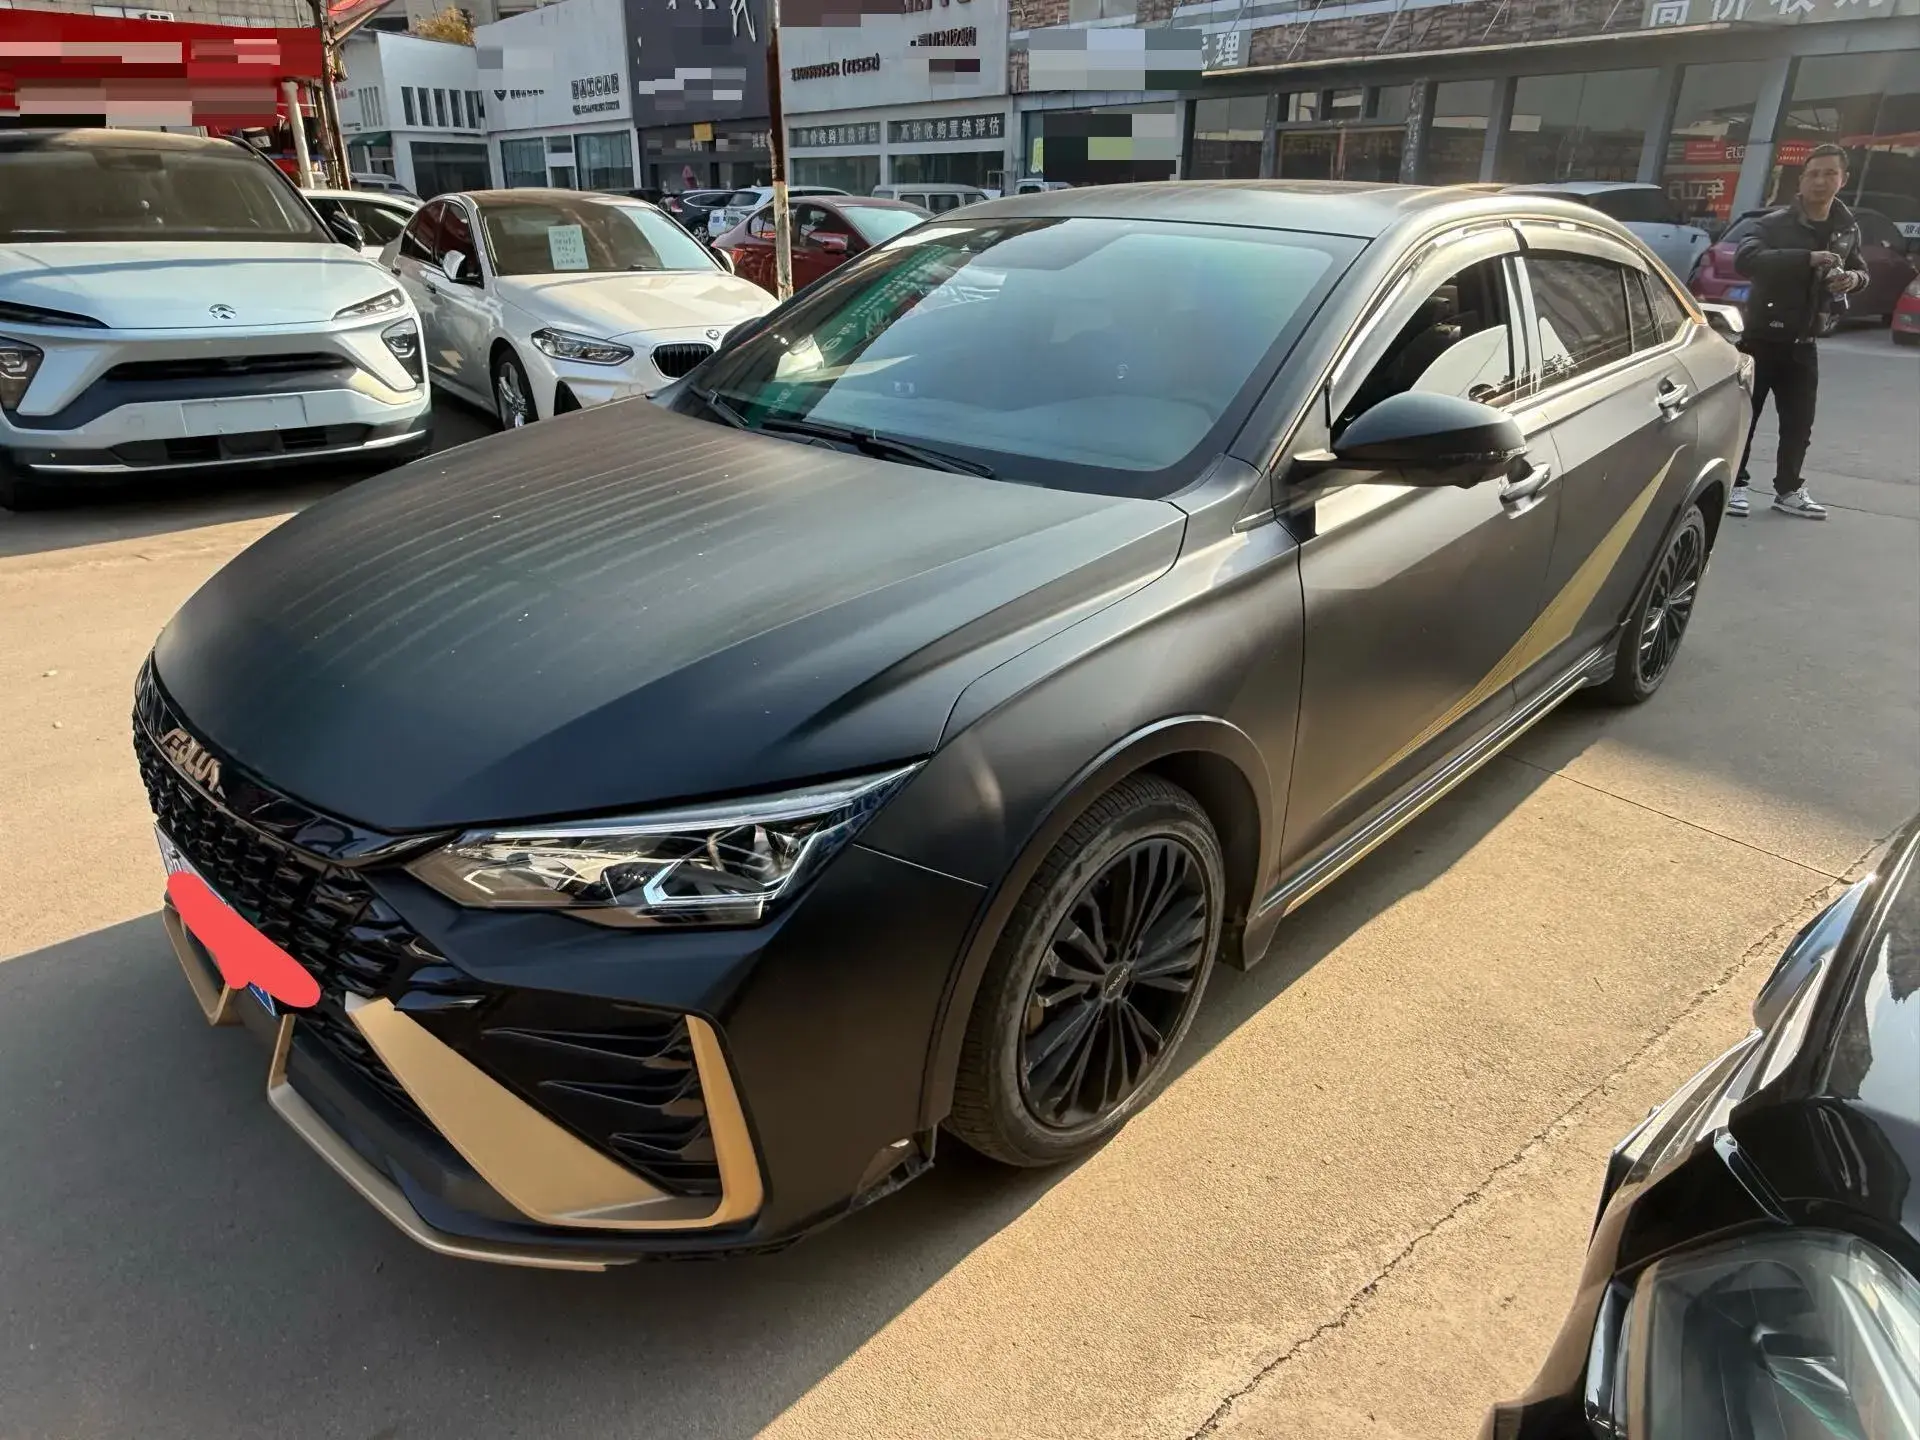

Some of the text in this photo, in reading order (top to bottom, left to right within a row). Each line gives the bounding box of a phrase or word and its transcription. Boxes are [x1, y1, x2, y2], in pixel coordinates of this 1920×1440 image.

[900, 116, 1000, 142] 高价收购置换评估
